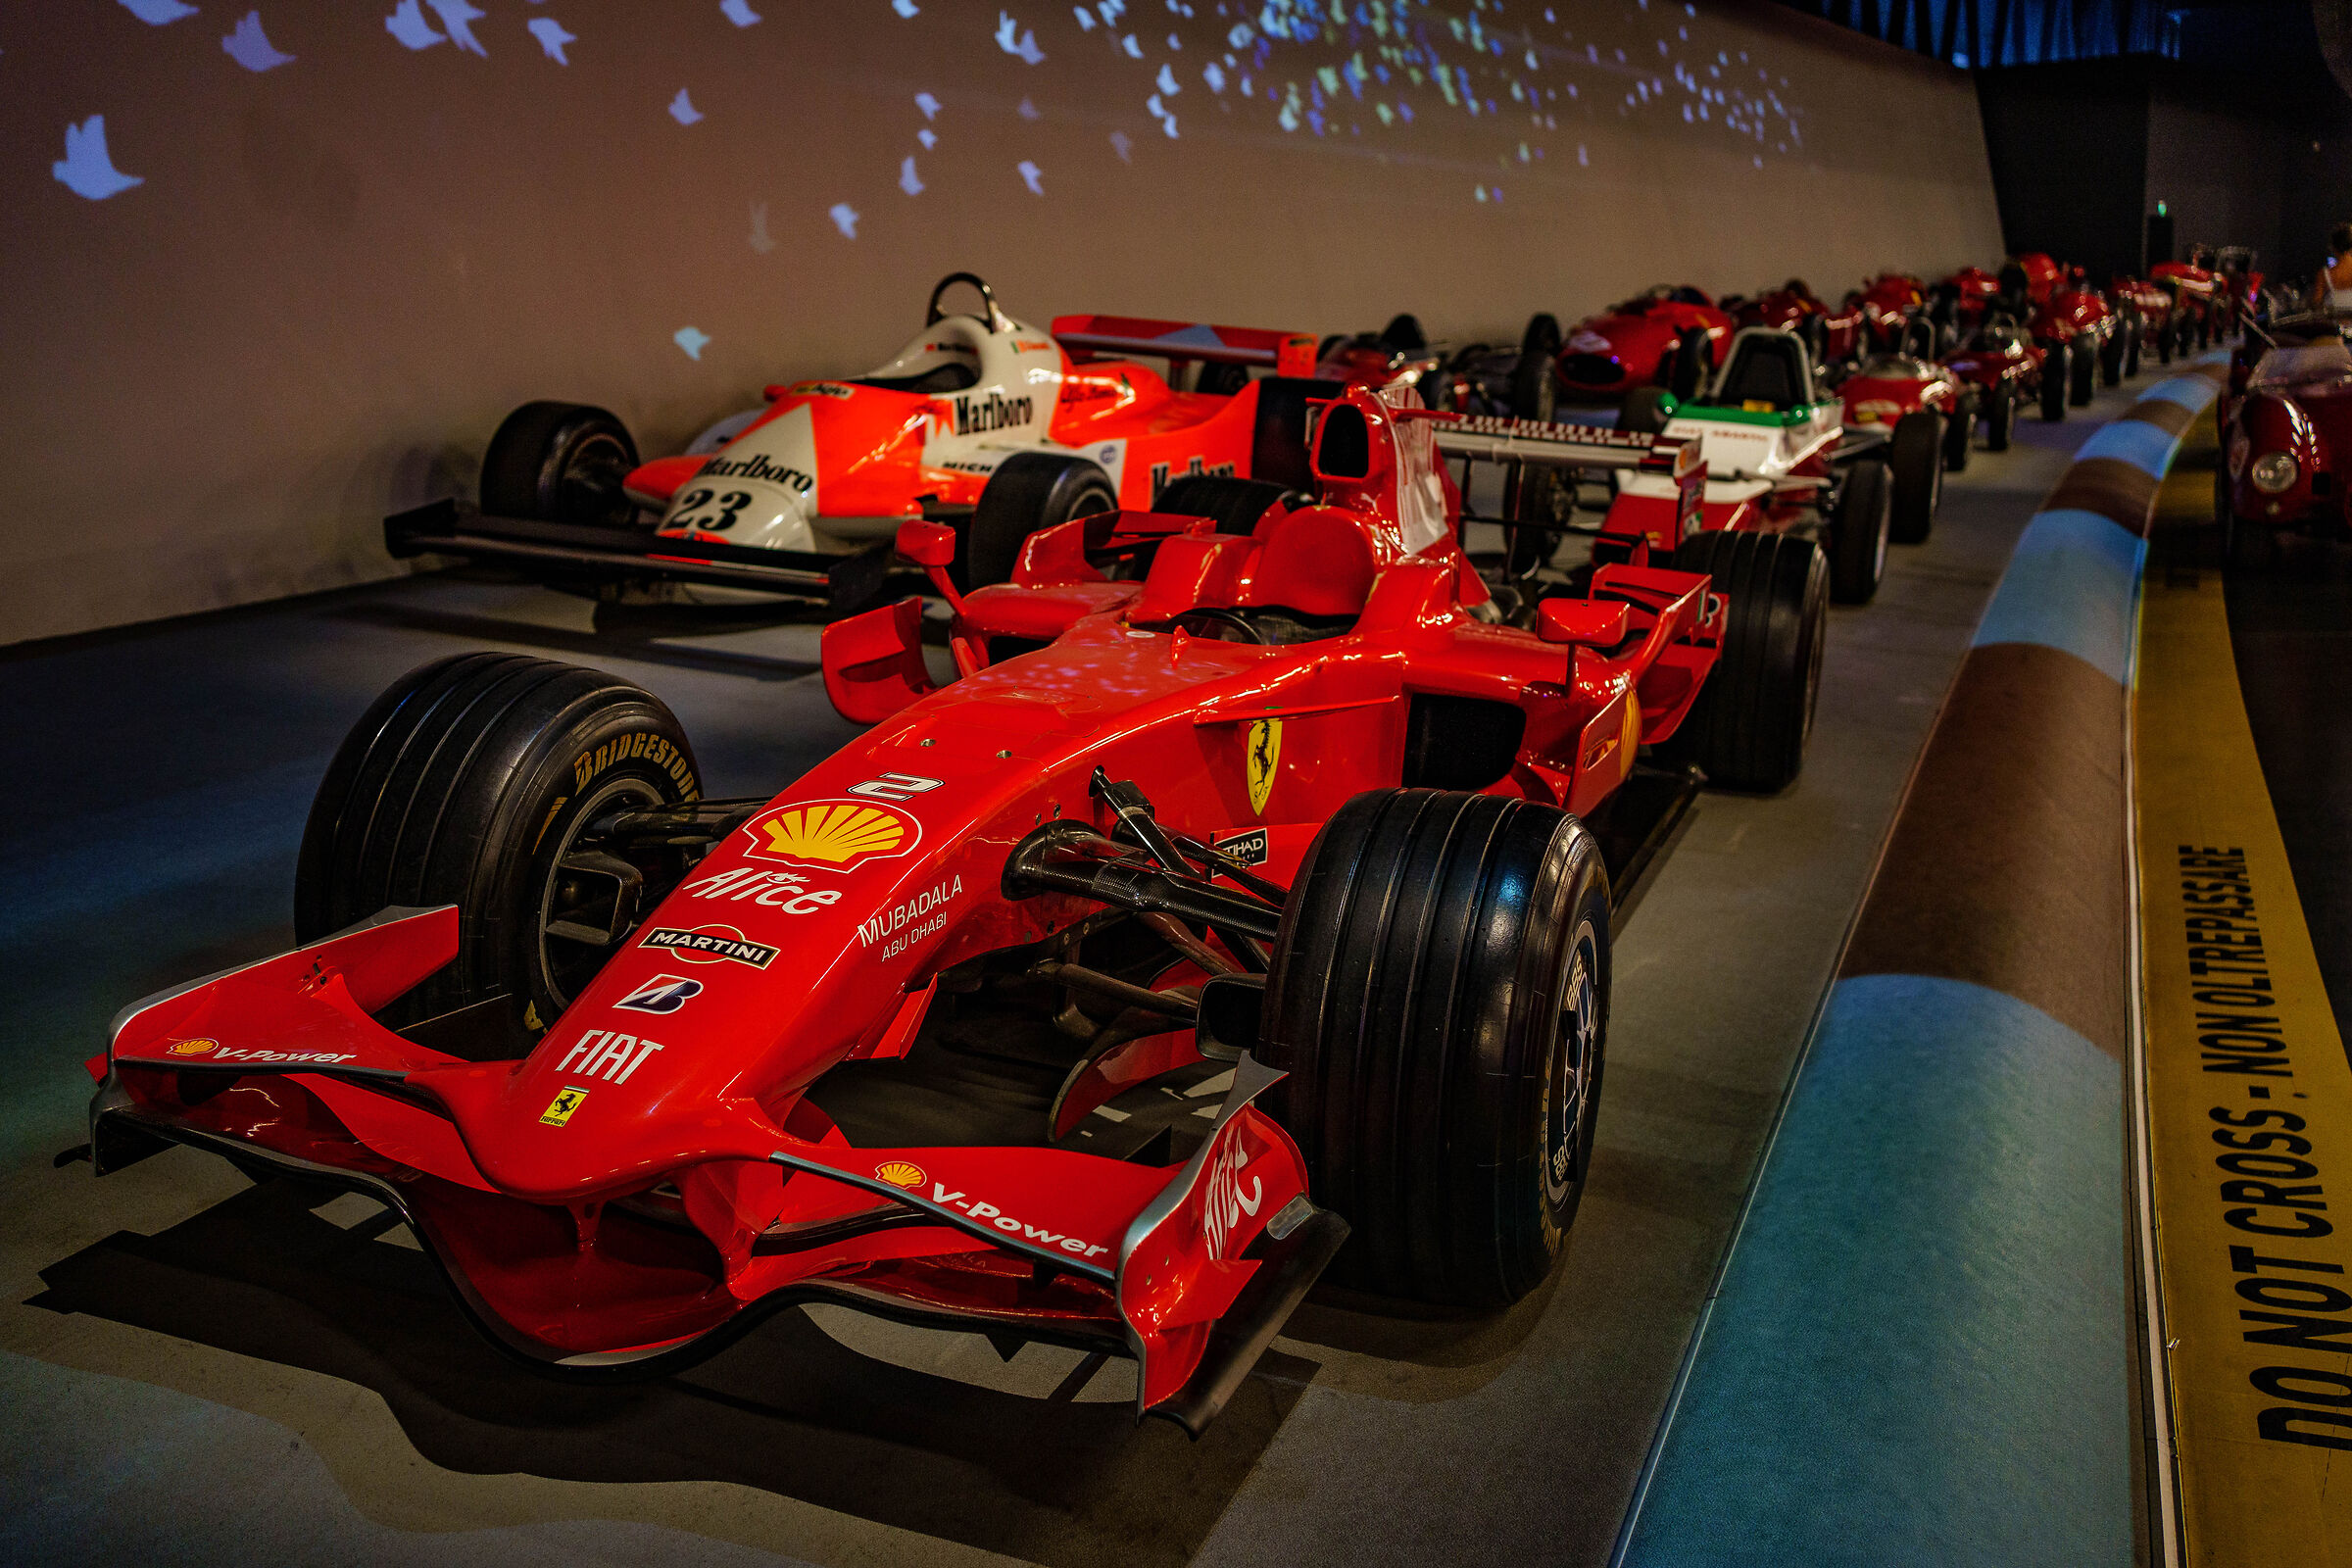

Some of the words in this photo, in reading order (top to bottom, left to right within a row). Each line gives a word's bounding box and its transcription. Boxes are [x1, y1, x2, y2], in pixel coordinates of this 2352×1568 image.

[956, 392, 1033, 436] Marlboro
[943, 462, 994, 473] MICH
[665, 488, 752, 530] 23
[846, 771, 946, 802] 2
[1222, 837, 1264, 857] TIHAD
[683, 867, 843, 914] Alice
[857, 874, 962, 949] MUBADALA
[650, 931, 767, 962] MARTINI
[881, 933, 908, 962] ABU
[910, 910, 948, 945] DHABI
[2178, 845, 2276, 1007] OLTREPASSARE
[212, 1047, 358, 1063] V-Power
[555, 1029, 665, 1085] FIAT
[2195, 1011, 2293, 1076] NON
[2208, 1106, 2333, 1239] CROSS
[932, 1182, 1109, 1257] V-Power
[2229, 1246, 2352, 1353] NOT
[2257, 1367, 2352, 1451] DO
